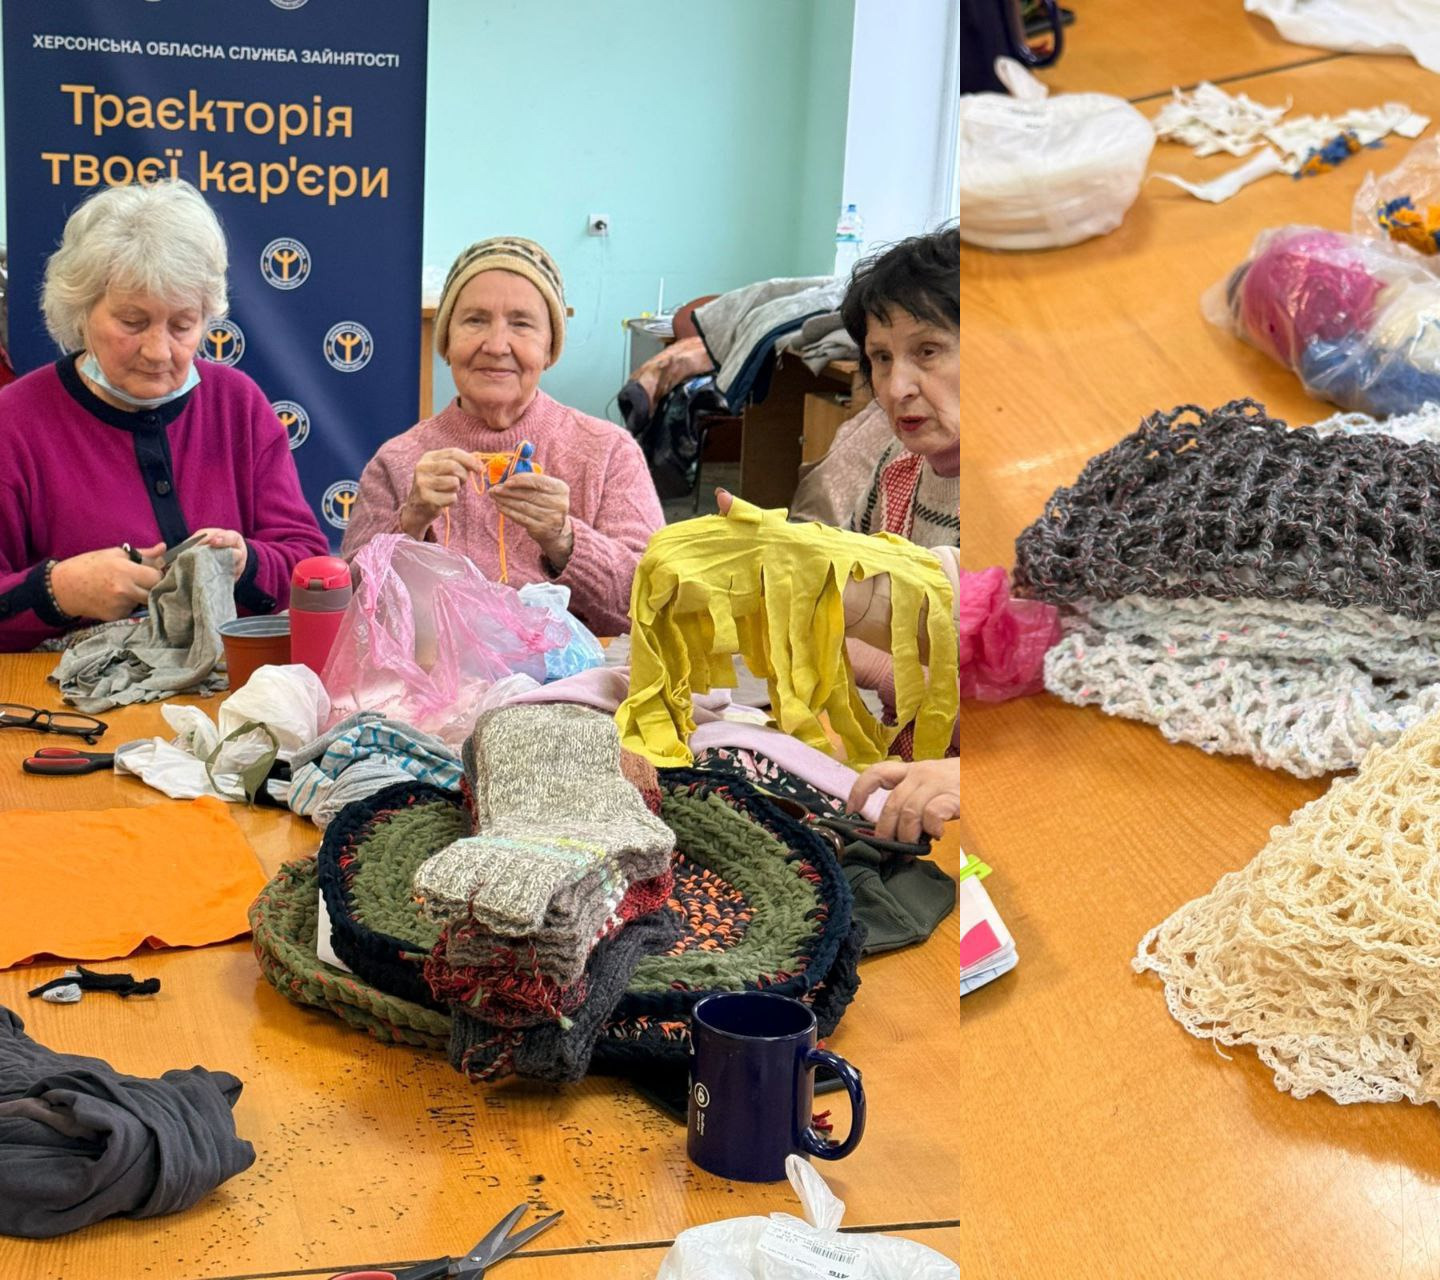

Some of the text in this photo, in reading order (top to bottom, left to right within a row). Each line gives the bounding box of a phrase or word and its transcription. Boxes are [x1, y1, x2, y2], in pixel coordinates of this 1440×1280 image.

[33, 35, 399, 67] ХЕРСОНСЬКА ОБЛАСНА СЛУЖБА ЗАЙНЯТОСТІ
[61, 84, 353, 144] Траєкторія
[41, 149, 389, 205] твоєї кар'єри
